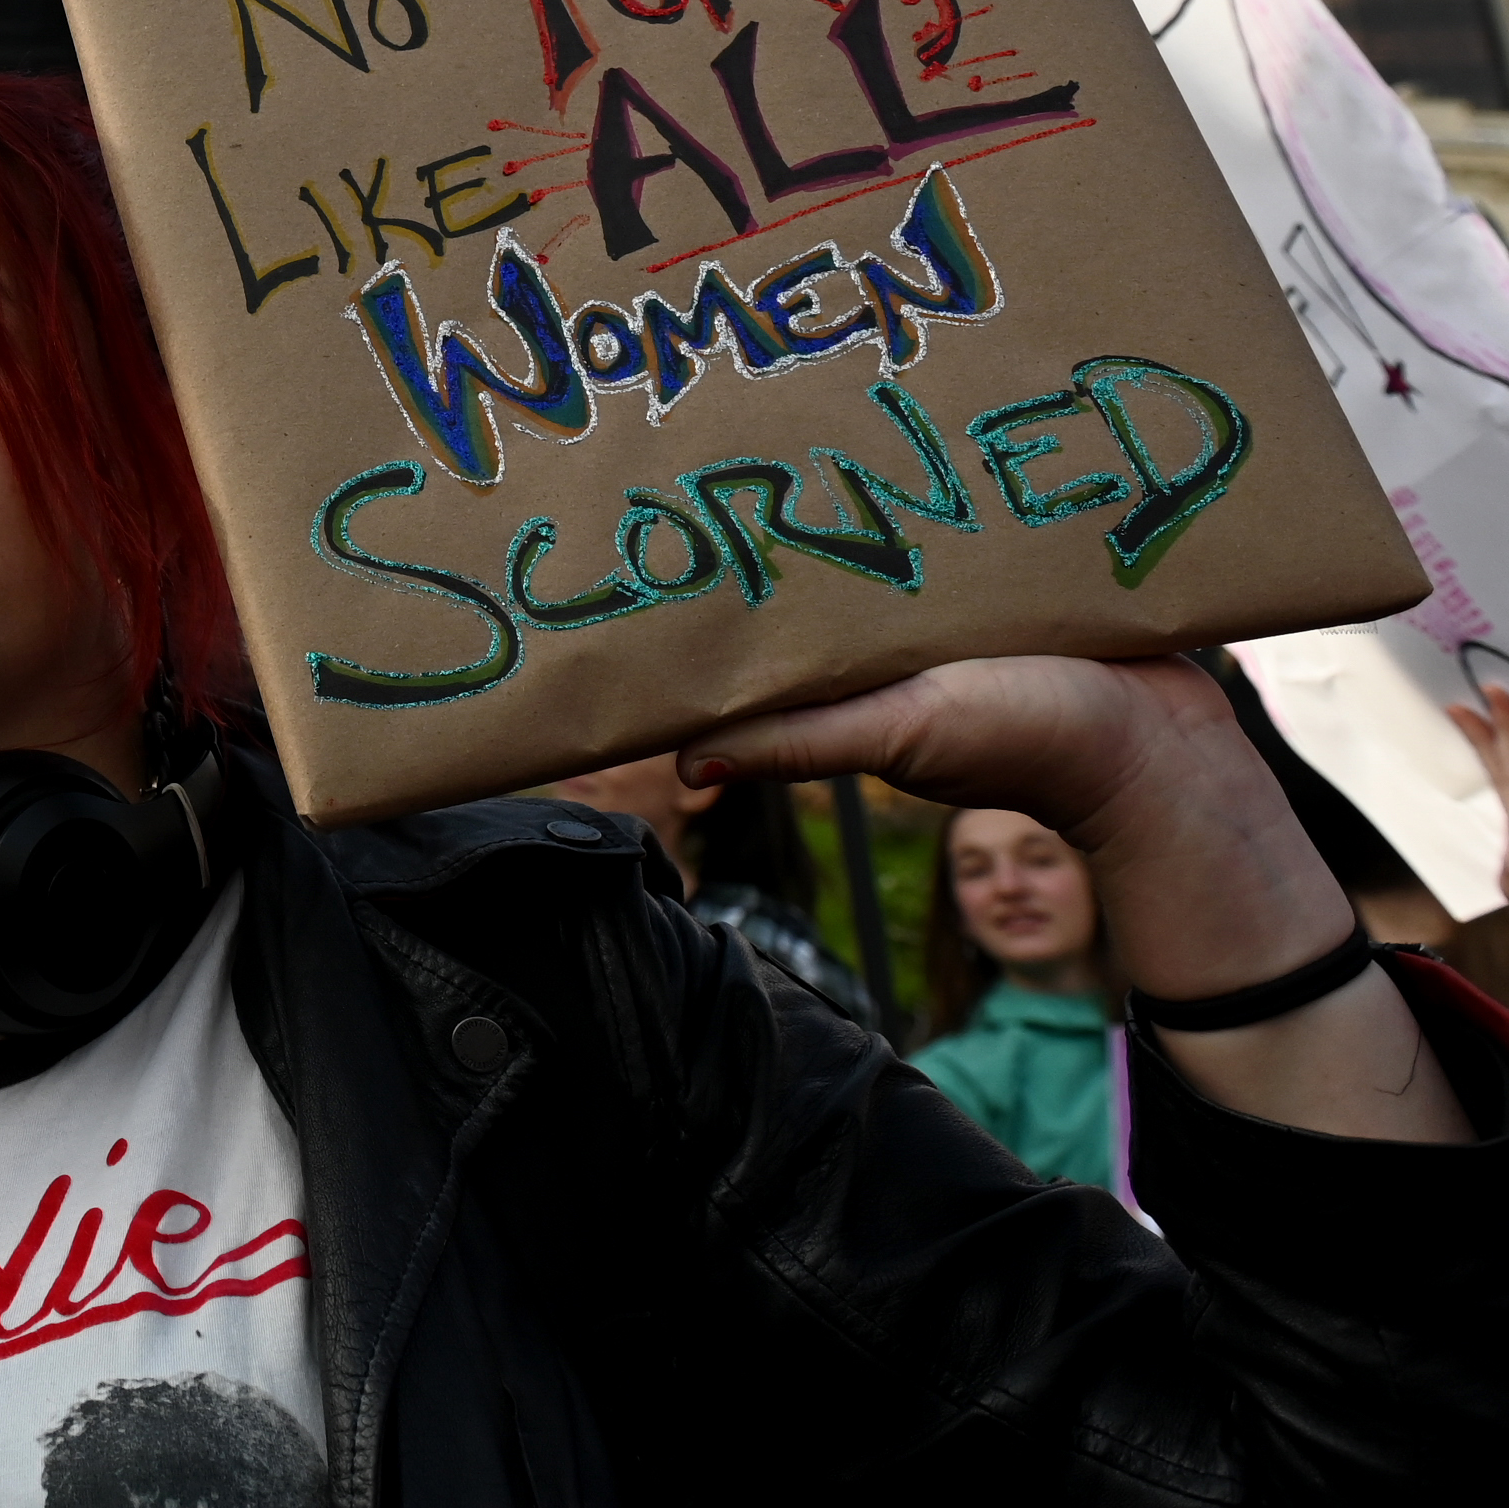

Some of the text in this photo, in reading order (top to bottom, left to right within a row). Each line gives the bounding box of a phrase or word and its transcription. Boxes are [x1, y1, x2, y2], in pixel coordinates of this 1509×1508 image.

[183, 121, 542, 314] LIKE
[341, 160, 1004, 490] WOMEN
[304, 355, 1252, 710] SCORNED
